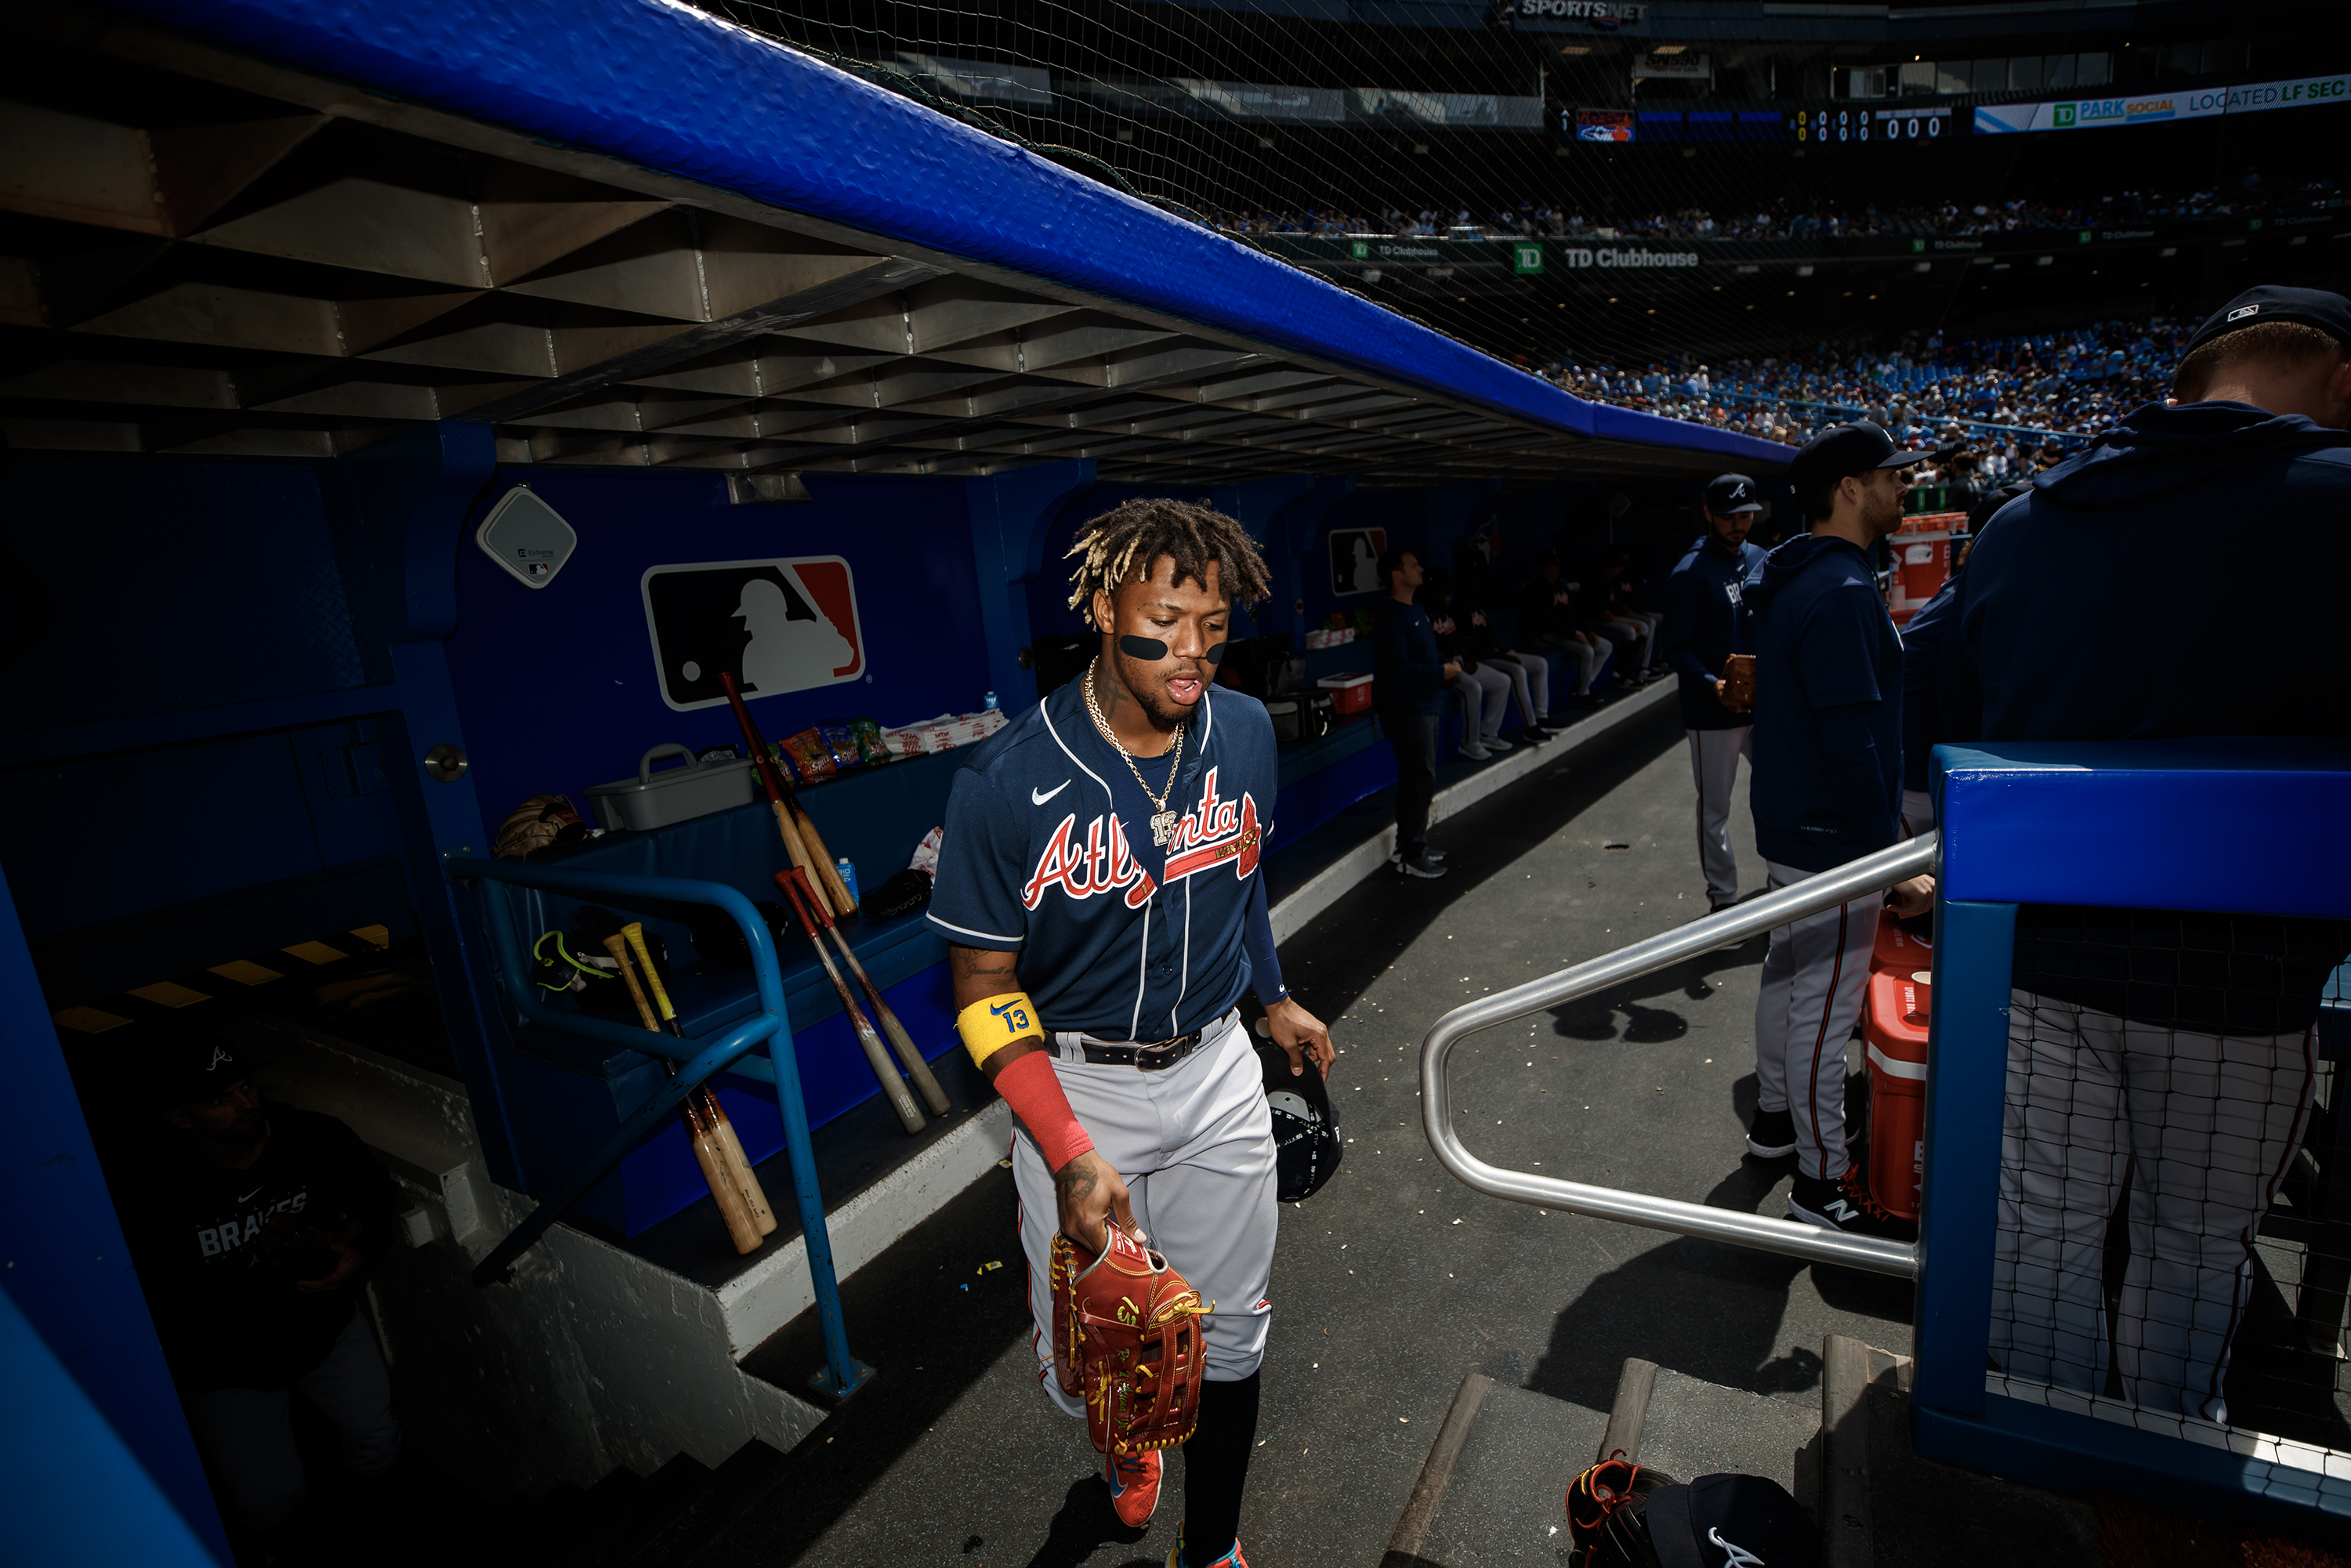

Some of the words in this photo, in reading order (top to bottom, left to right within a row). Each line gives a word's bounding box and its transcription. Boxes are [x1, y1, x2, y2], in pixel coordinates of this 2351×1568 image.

[1521, 0, 1648, 20] SPORTSNET
[2190, 87, 2277, 111] LOCATED
[2281, 85, 2303, 102] LF
[2307, 79, 2346, 99] SEC
[2081, 100, 2125, 117] PARK
[2126, 100, 2175, 114] SOCIAL
[1887, 119, 1900, 139] 0
[1907, 118, 1920, 139] 0
[1928, 116, 1940, 138] 0
[1392, 245, 1439, 257] Clubhouse
[1519, 248, 1542, 268] TD
[1565, 248, 1593, 268] TD
[1593, 247, 1700, 268] Clubhouse
[841, 746, 858, 764] Spitz
[870, 739, 886, 756] Spitz
[810, 754, 831, 773] Spitz
[1020, 765, 1238, 912] Atlnta
[1904, 987, 1915, 1002] SPORTS
[1003, 1009, 1030, 1033] 13
